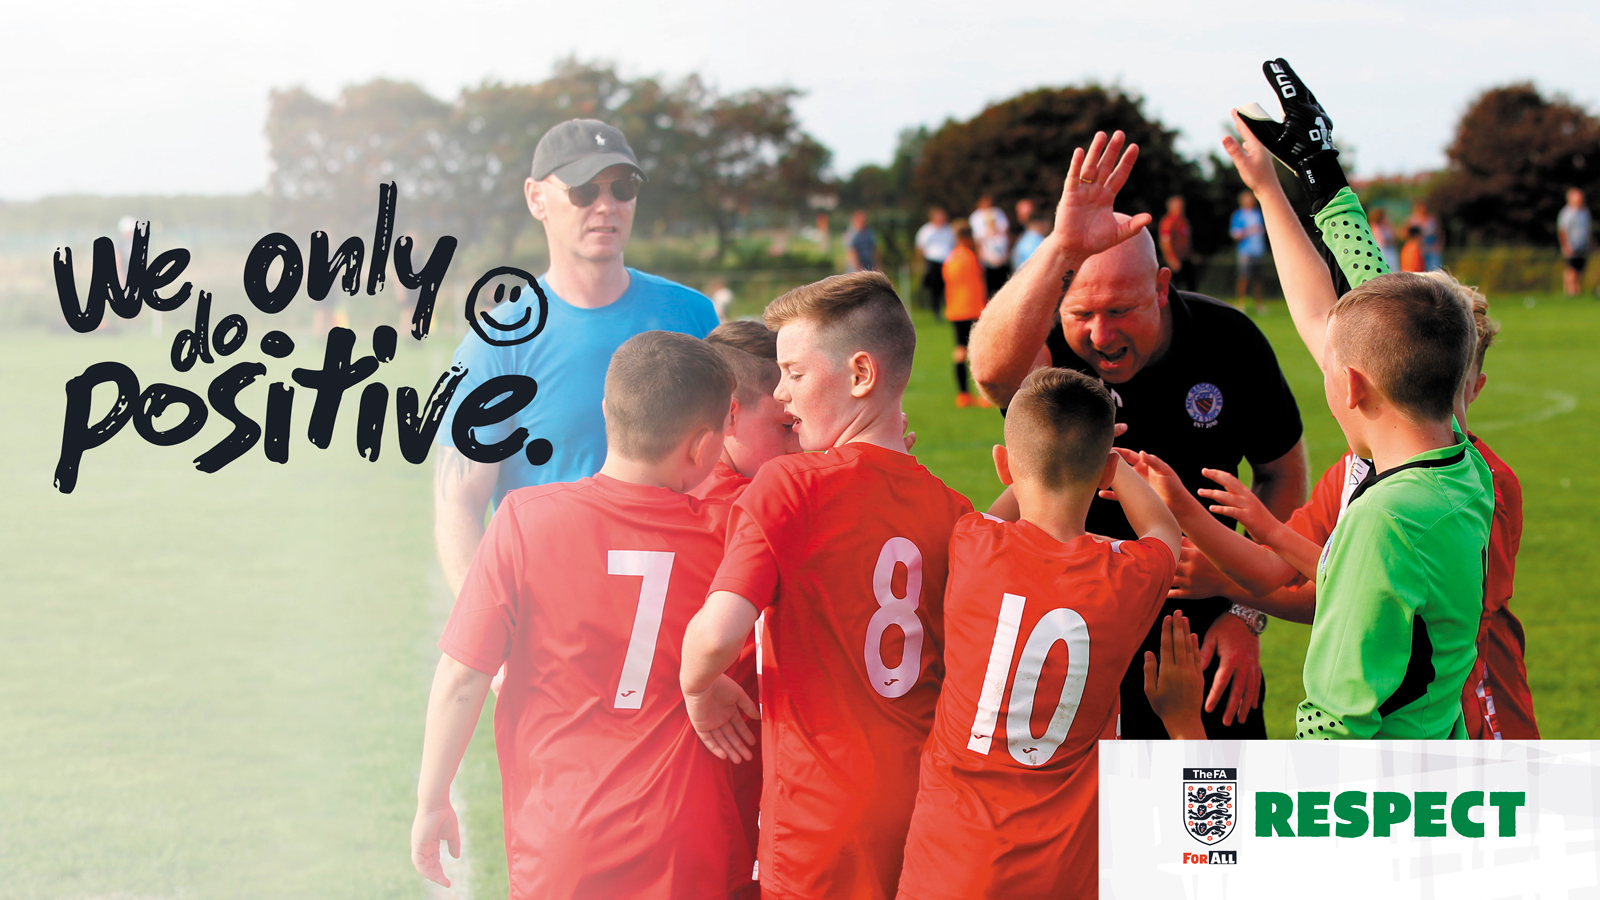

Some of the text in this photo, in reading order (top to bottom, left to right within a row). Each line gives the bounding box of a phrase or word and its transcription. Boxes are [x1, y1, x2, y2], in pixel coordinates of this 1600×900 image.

[607, 549, 676, 710] 7
[864, 536, 924, 699] 8
[966, 592, 1091, 767] 10
